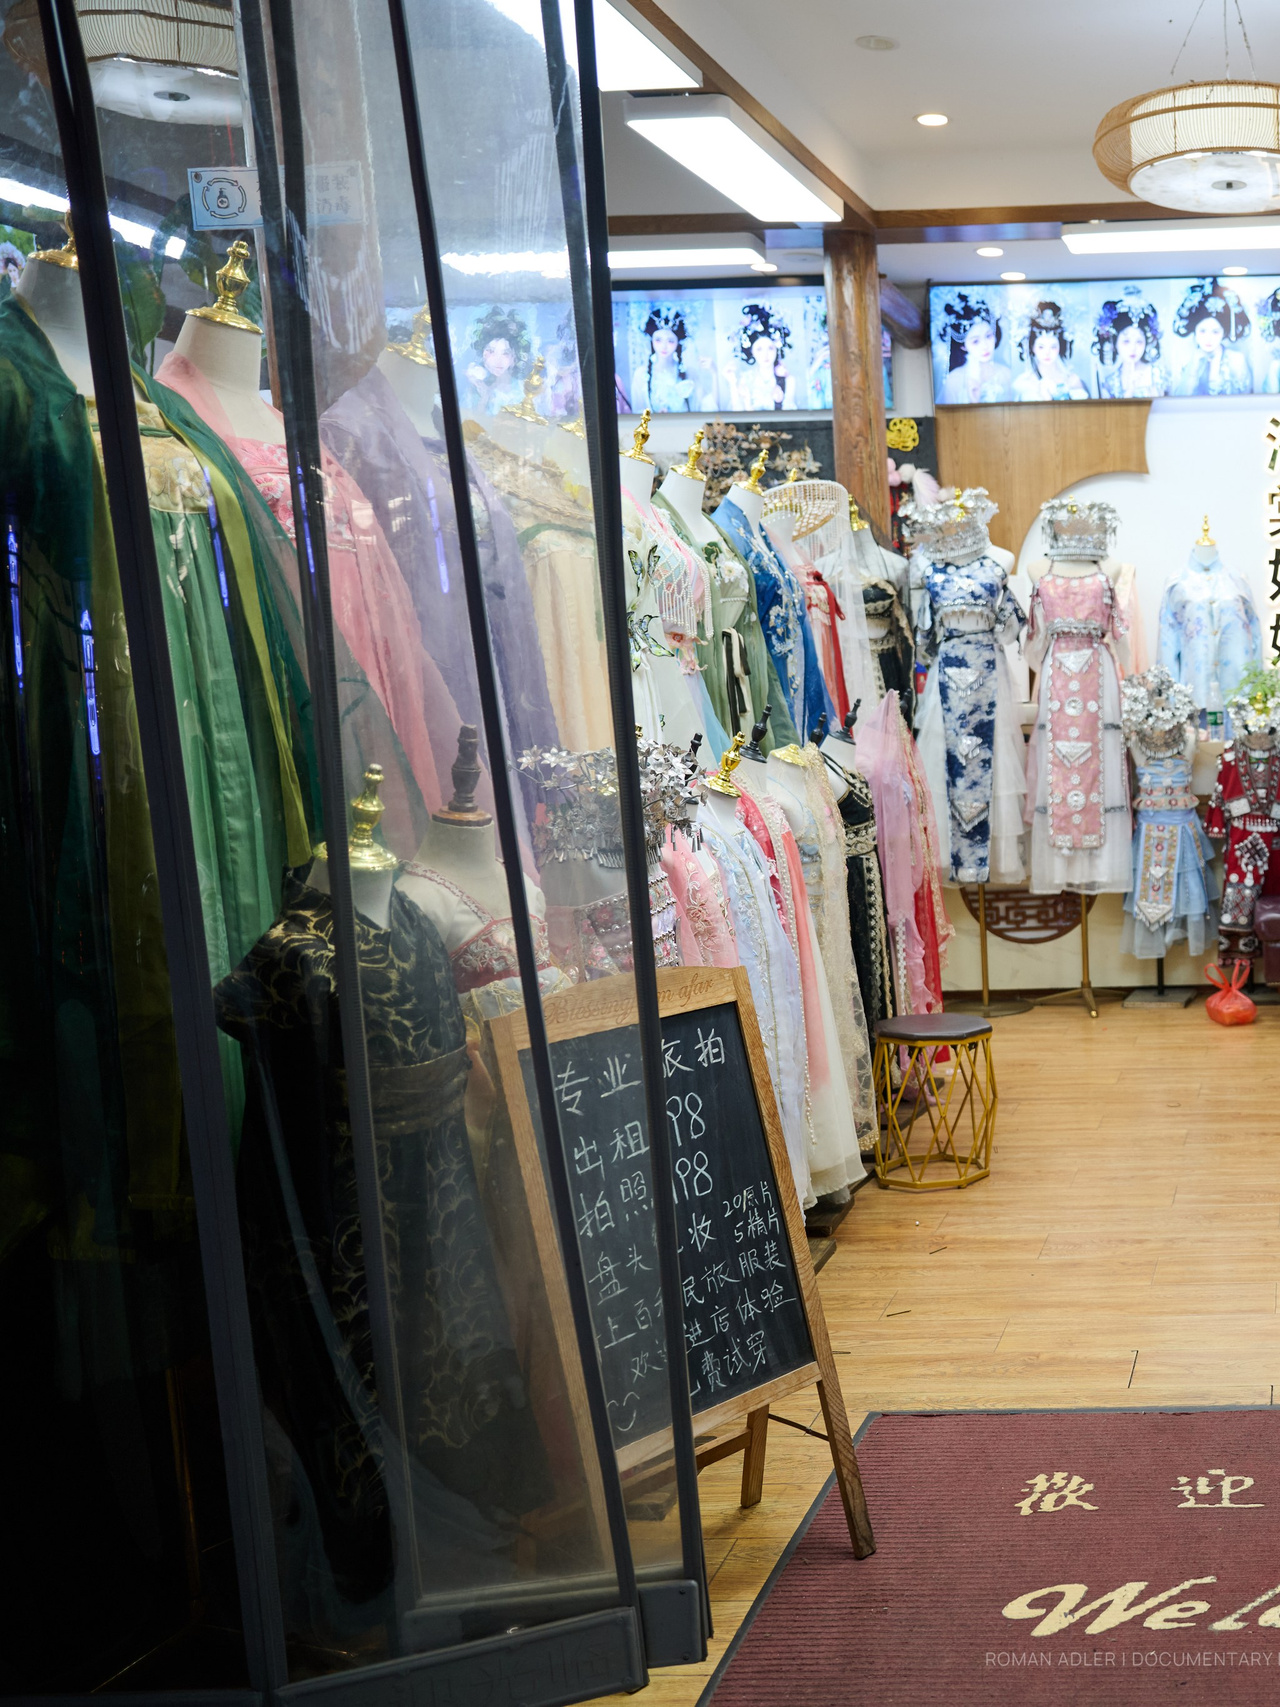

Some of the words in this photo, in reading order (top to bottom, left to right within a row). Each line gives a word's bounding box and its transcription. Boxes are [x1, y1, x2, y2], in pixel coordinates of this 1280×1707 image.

[574, 1120, 650, 1181] 出租
[577, 1170, 655, 1240] 拍照
[588, 1212, 717, 1306] 盘头妆
[690, 1330, 767, 1397] 费试穿
